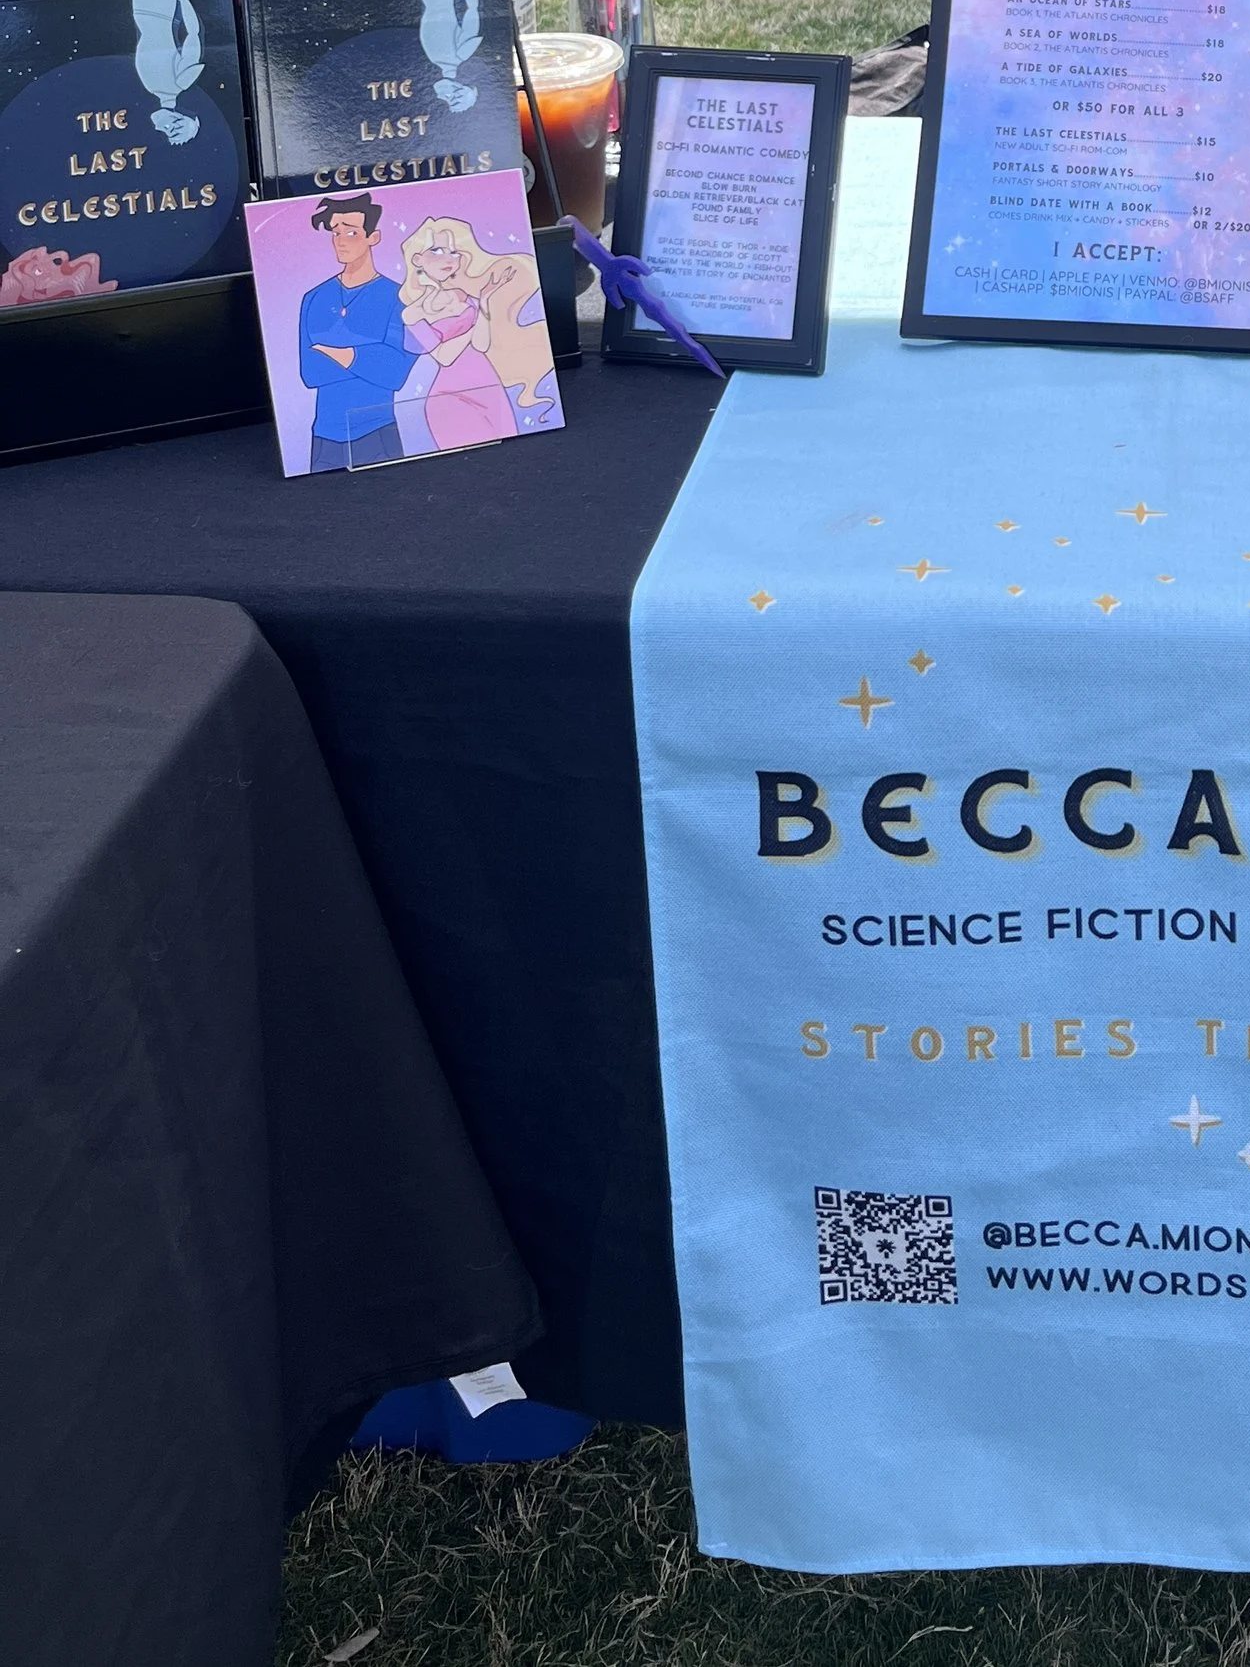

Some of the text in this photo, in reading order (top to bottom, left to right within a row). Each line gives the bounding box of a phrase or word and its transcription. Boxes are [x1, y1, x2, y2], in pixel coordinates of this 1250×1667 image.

[1095, 0, 1132, 9] STARS
[1207, 5, 1226, 14] $18
[1005, 29, 1224, 48] A SEA OF WORLDS $18
[1001, 63, 1222, 82] A TIDE OF GALAXIES $20
[367, 79, 413, 101] THE
[697, 99, 779, 116] THE LAST
[1053, 101, 1183, 117] OR $50 FOR ALL 3
[76, 110, 128, 132] THE
[360, 115, 429, 141] LAST
[687, 116, 784, 134] CELESTIALS
[996, 127, 1216, 147] THE LAST CELESTIALS $15
[657, 141, 809, 160] SCI-FI ROMANTIC COMEDY
[69, 147, 147, 176] LAST
[313, 150, 493, 189] CELESTIALS
[993, 162, 1214, 182] PORTALS & DOORWAYS $10
[17, 185, 218, 225] CELESTIALS
[990, 196, 1212, 216] BLIND DATE WITH A BOOK $12
[1194, 221, 1250, 232] OR 2/$20
[1053, 242, 1162, 262] I ACCEPT:
[954, 266, 990, 279] CASH
[1001, 268, 1038, 281] CARD
[1049, 271, 1090, 284] APPLE
[1094, 273, 1119, 285] PAY
[1050, 284, 1113, 298] $BMIONIS
[1180, 291, 1235, 305] @BSAFF
[755, 768, 1243, 861] BECCA
[822, 911, 1022, 946] SCIENCE
[1047, 908, 1237, 943] FICTION
[800, 1019, 1137, 1062] STORIES
